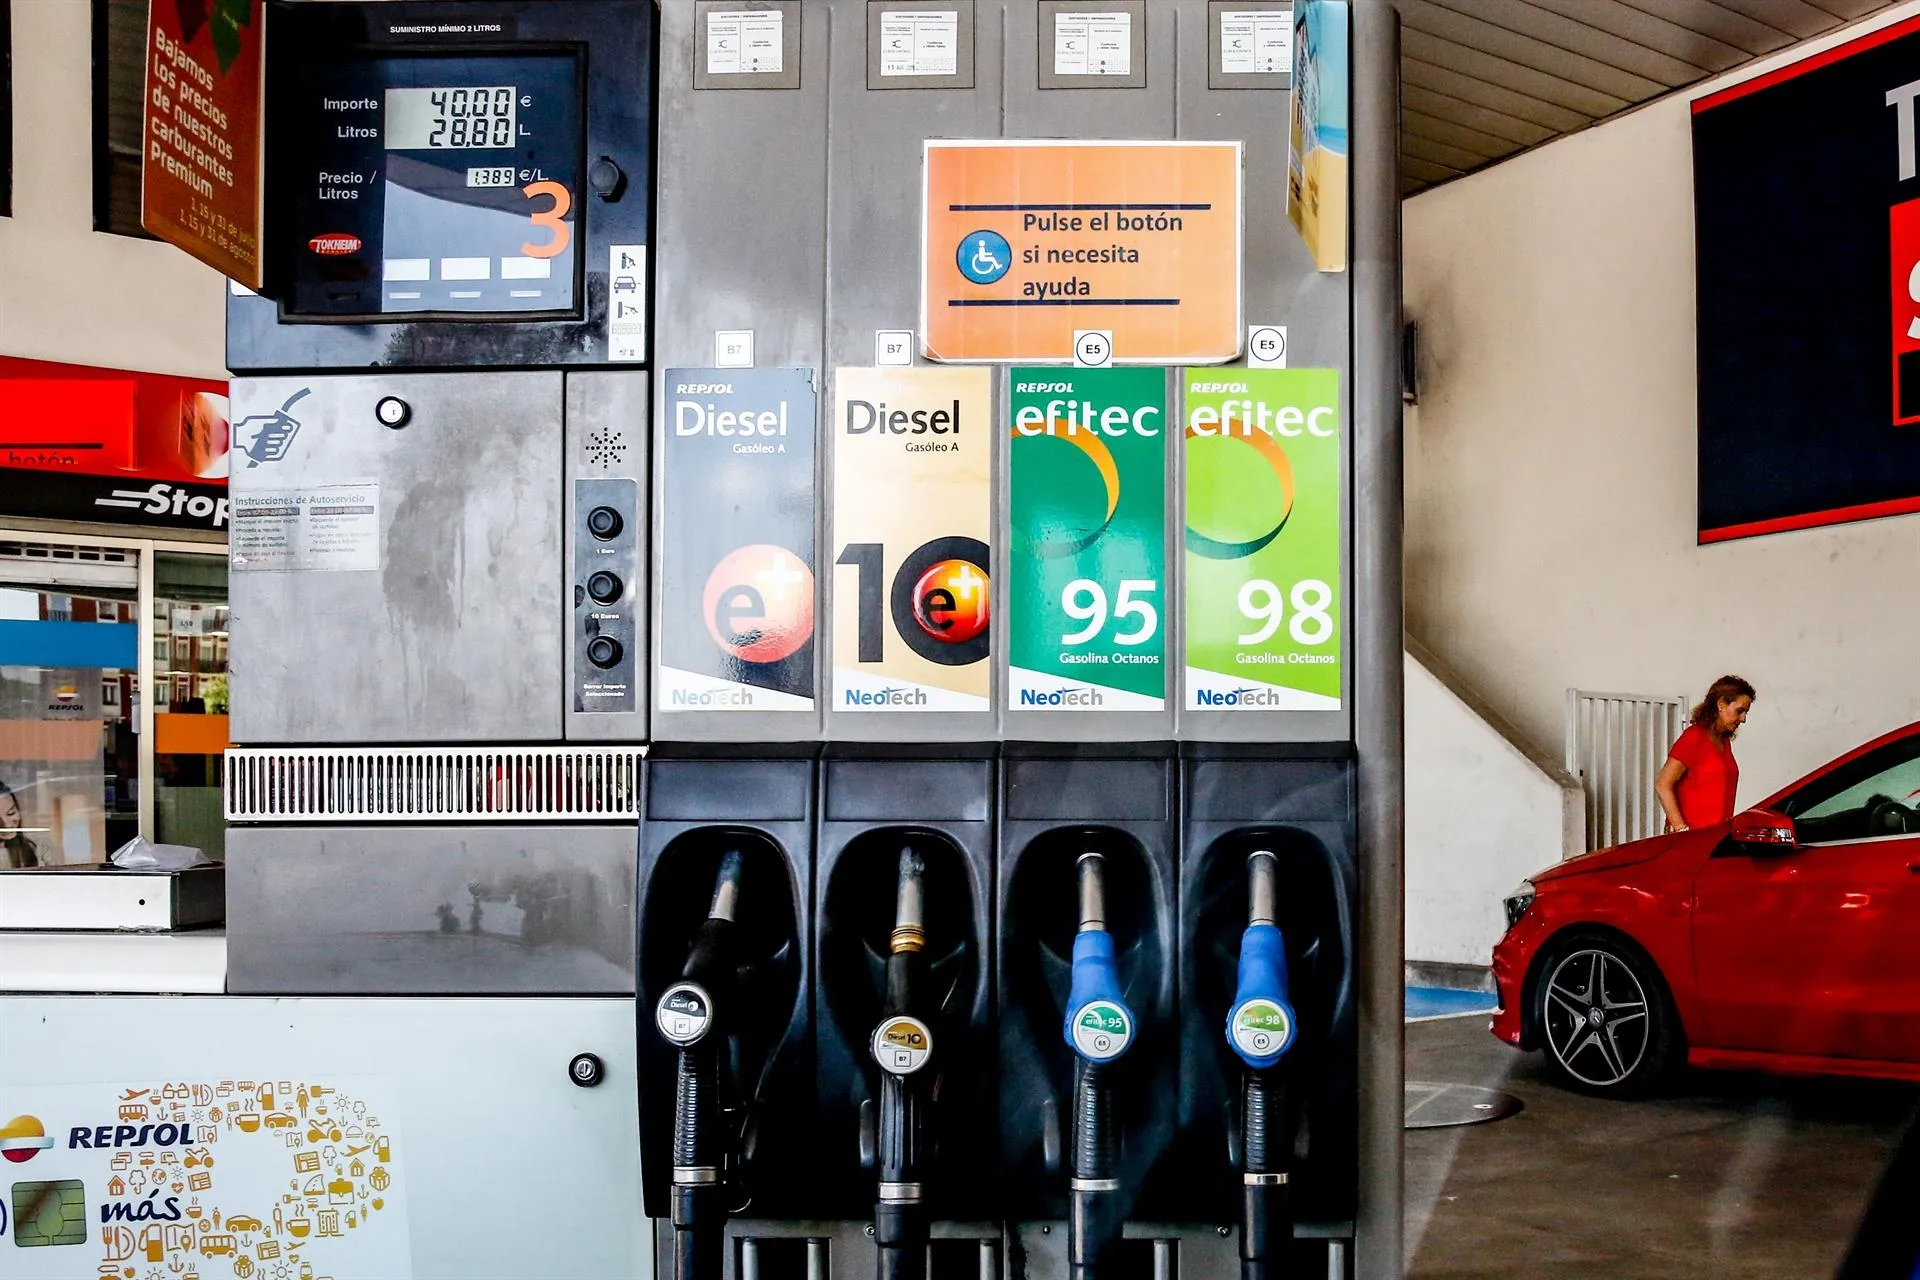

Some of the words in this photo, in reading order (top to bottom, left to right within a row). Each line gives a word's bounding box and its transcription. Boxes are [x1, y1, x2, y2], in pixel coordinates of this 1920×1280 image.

[390, 26, 437, 34] SUMINISTRO
[438, 24, 466, 33] MÍNIMO
[155, 27, 214, 91] Bajamos
[155, 53, 176, 89] los
[180, 80, 228, 130] precios
[324, 98, 378, 112] Importe
[430, 89, 511, 118] 40,00
[519, 96, 532, 107] €
[153, 85, 170, 114] de
[174, 105, 233, 160] nuestros
[338, 126, 378, 138] Litros
[429, 118, 511, 147] 28,80
[151, 116, 234, 188] carburantes
[151, 140, 213, 200] Premium
[319, 172, 363, 184] Precio
[519, 168, 549, 182] €/L.
[319, 187, 359, 199] Litros
[520, 180, 572, 259] 3
[1023, 212, 1082, 232] Pulse
[1089, 212, 1108, 232] el
[1116, 211, 1183, 232] botón
[309, 239, 358, 253] TOKHEIM
[1023, 245, 1039, 264] si
[1047, 244, 1140, 264] necesita
[1022, 277, 1091, 300] ayuda
[727, 344, 742, 354] B7
[886, 344, 902, 354] B7
[1085, 344, 1101, 354] E5
[1259, 339, 1275, 350] E5
[676, 383, 734, 394] REPSOL
[1016, 382, 1074, 393] REPSOL
[1190, 382, 1249, 393] REPSOL
[675, 400, 787, 437] Diesel
[846, 400, 960, 434] Diesel
[1015, 400, 1160, 437] efitec
[1190, 400, 1334, 437] efitec
[732, 443, 775, 454] Gasóleo
[778, 444, 786, 453] A
[905, 442, 948, 452] Gasóleo
[951, 443, 959, 452] A
[235, 496, 294, 505] Instrucciones
[296, 495, 307, 504] de
[309, 494, 365, 504] Autoservicio
[1061, 579, 1158, 645] 95
[1237, 579, 1334, 645] 98
[1059, 652, 1109, 664] Gasolina
[1112, 652, 1160, 664] Octanos
[1235, 652, 1285, 664] Gasolina
[1288, 652, 1336, 664] Octanos
[846, 686, 927, 706] NeoTech
[1021, 687, 1103, 706] NeoTech
[1197, 687, 1280, 706] NeoTech
[1108, 1017, 1123, 1028] 95
[1265, 1014, 1280, 1025] 98
[907, 1033, 922, 1044] 10
[69, 1122, 195, 1149] REPSOL
[101, 1188, 182, 1223] más
